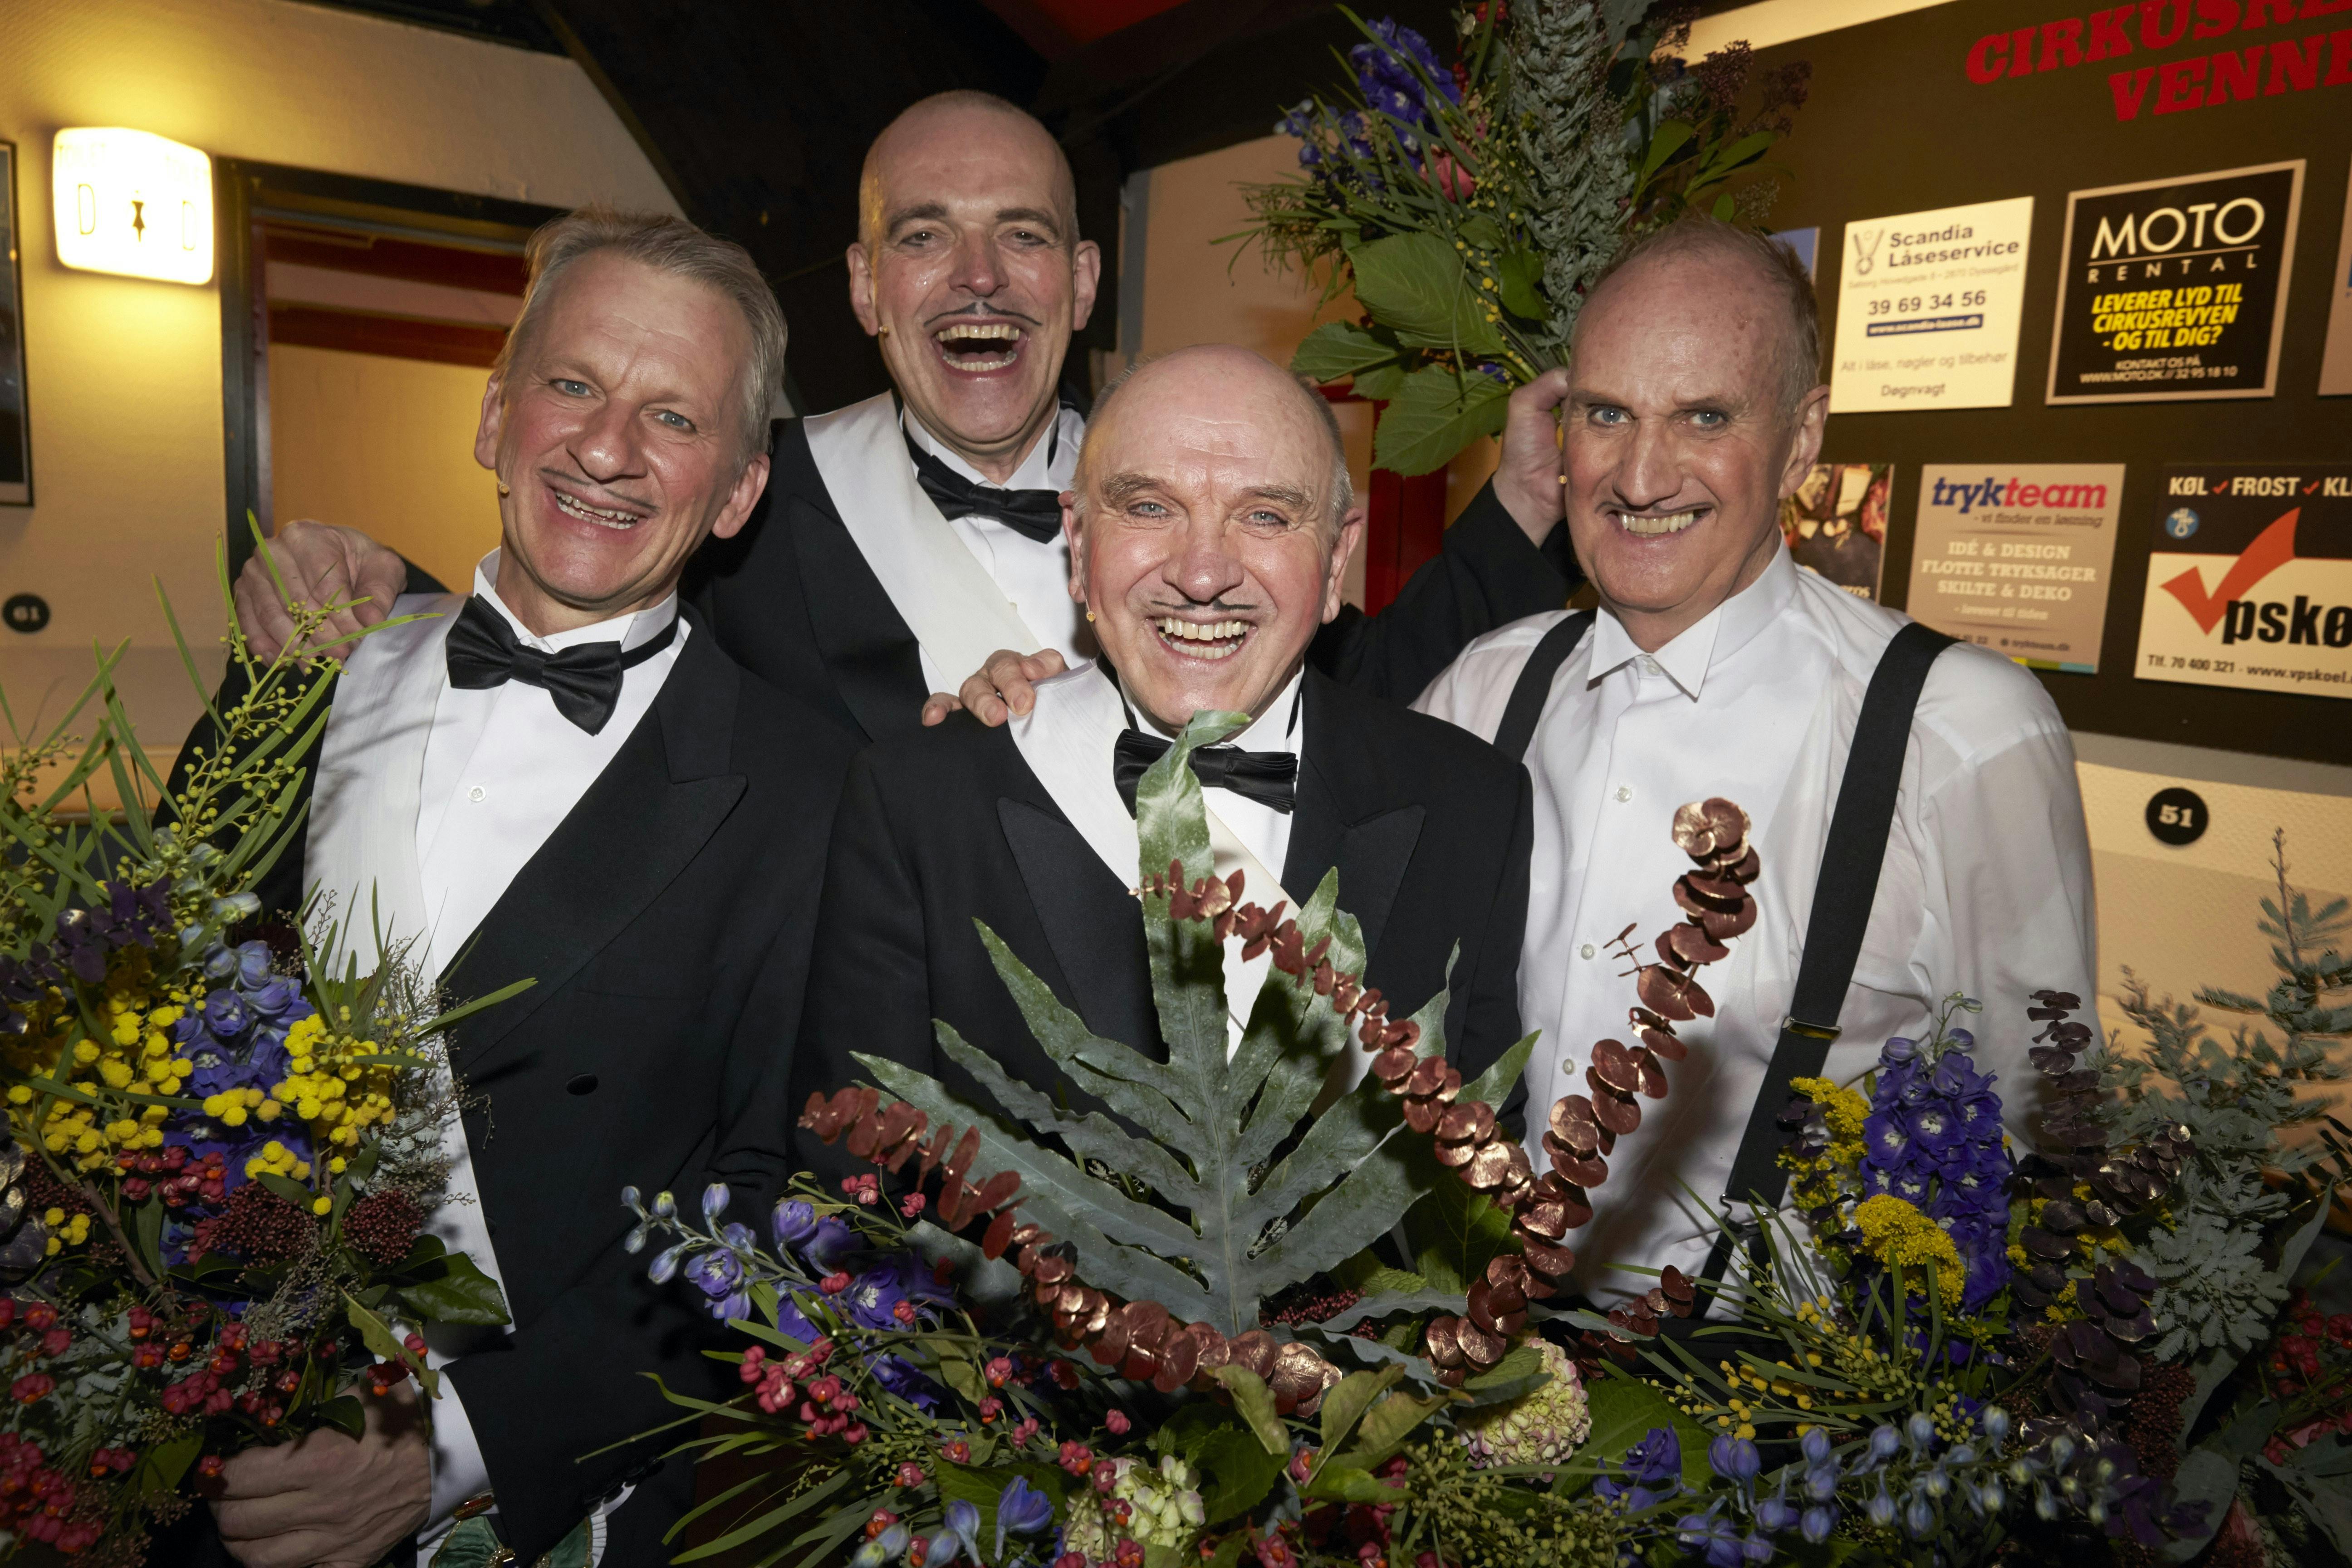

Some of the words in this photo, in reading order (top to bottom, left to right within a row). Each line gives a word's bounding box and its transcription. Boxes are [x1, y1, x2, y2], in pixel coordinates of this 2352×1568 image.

[1890, 224, 1974, 248] Scandia
[2090, 197, 2265, 260] MOTO
[2087, 253, 2258, 284] RENTAL
[1867, 299, 1891, 315] 39
[1898, 297, 1921, 313] 69
[1929, 293, 1953, 310] 34
[1961, 290, 1986, 307] 56
[2092, 289, 2173, 314] LEVERER
[2174, 285, 2212, 307] LYD
[2215, 282, 2243, 304] TIL
[2092, 304, 2240, 333] CIRKUSREVYEN
[2112, 331, 2142, 351] OG
[2144, 329, 2171, 349] TIL
[2173, 324, 2223, 347] DIG?
[1939, 356, 1955, 369] og
[1881, 383, 1946, 398] Døgnvagt
[1932, 477, 2107, 514] trykteam
[2168, 476, 2208, 496] KØL
[2231, 476, 2301, 497] FROST
[2323, 476, 2352, 497] KL
[1947, 538, 1979, 556] IDÉ
[1982, 543, 1996, 557] &
[2000, 543, 2072, 559] DESIGN
[1921, 560, 1985, 576] FLOTTE
[1988, 563, 2097, 582] TRYKSAGER
[1937, 580, 1997, 597] SKILTE
[2000, 583, 2014, 598] &
[2018, 584, 2073, 602] DEKO
[2170, 657, 2185, 668] 70
[2188, 658, 2210, 671] 400
[2213, 660, 2235, 673] 321
[2247, 664, 2352, 684] www.vpskoel.
[2158, 803, 2193, 828] 51
